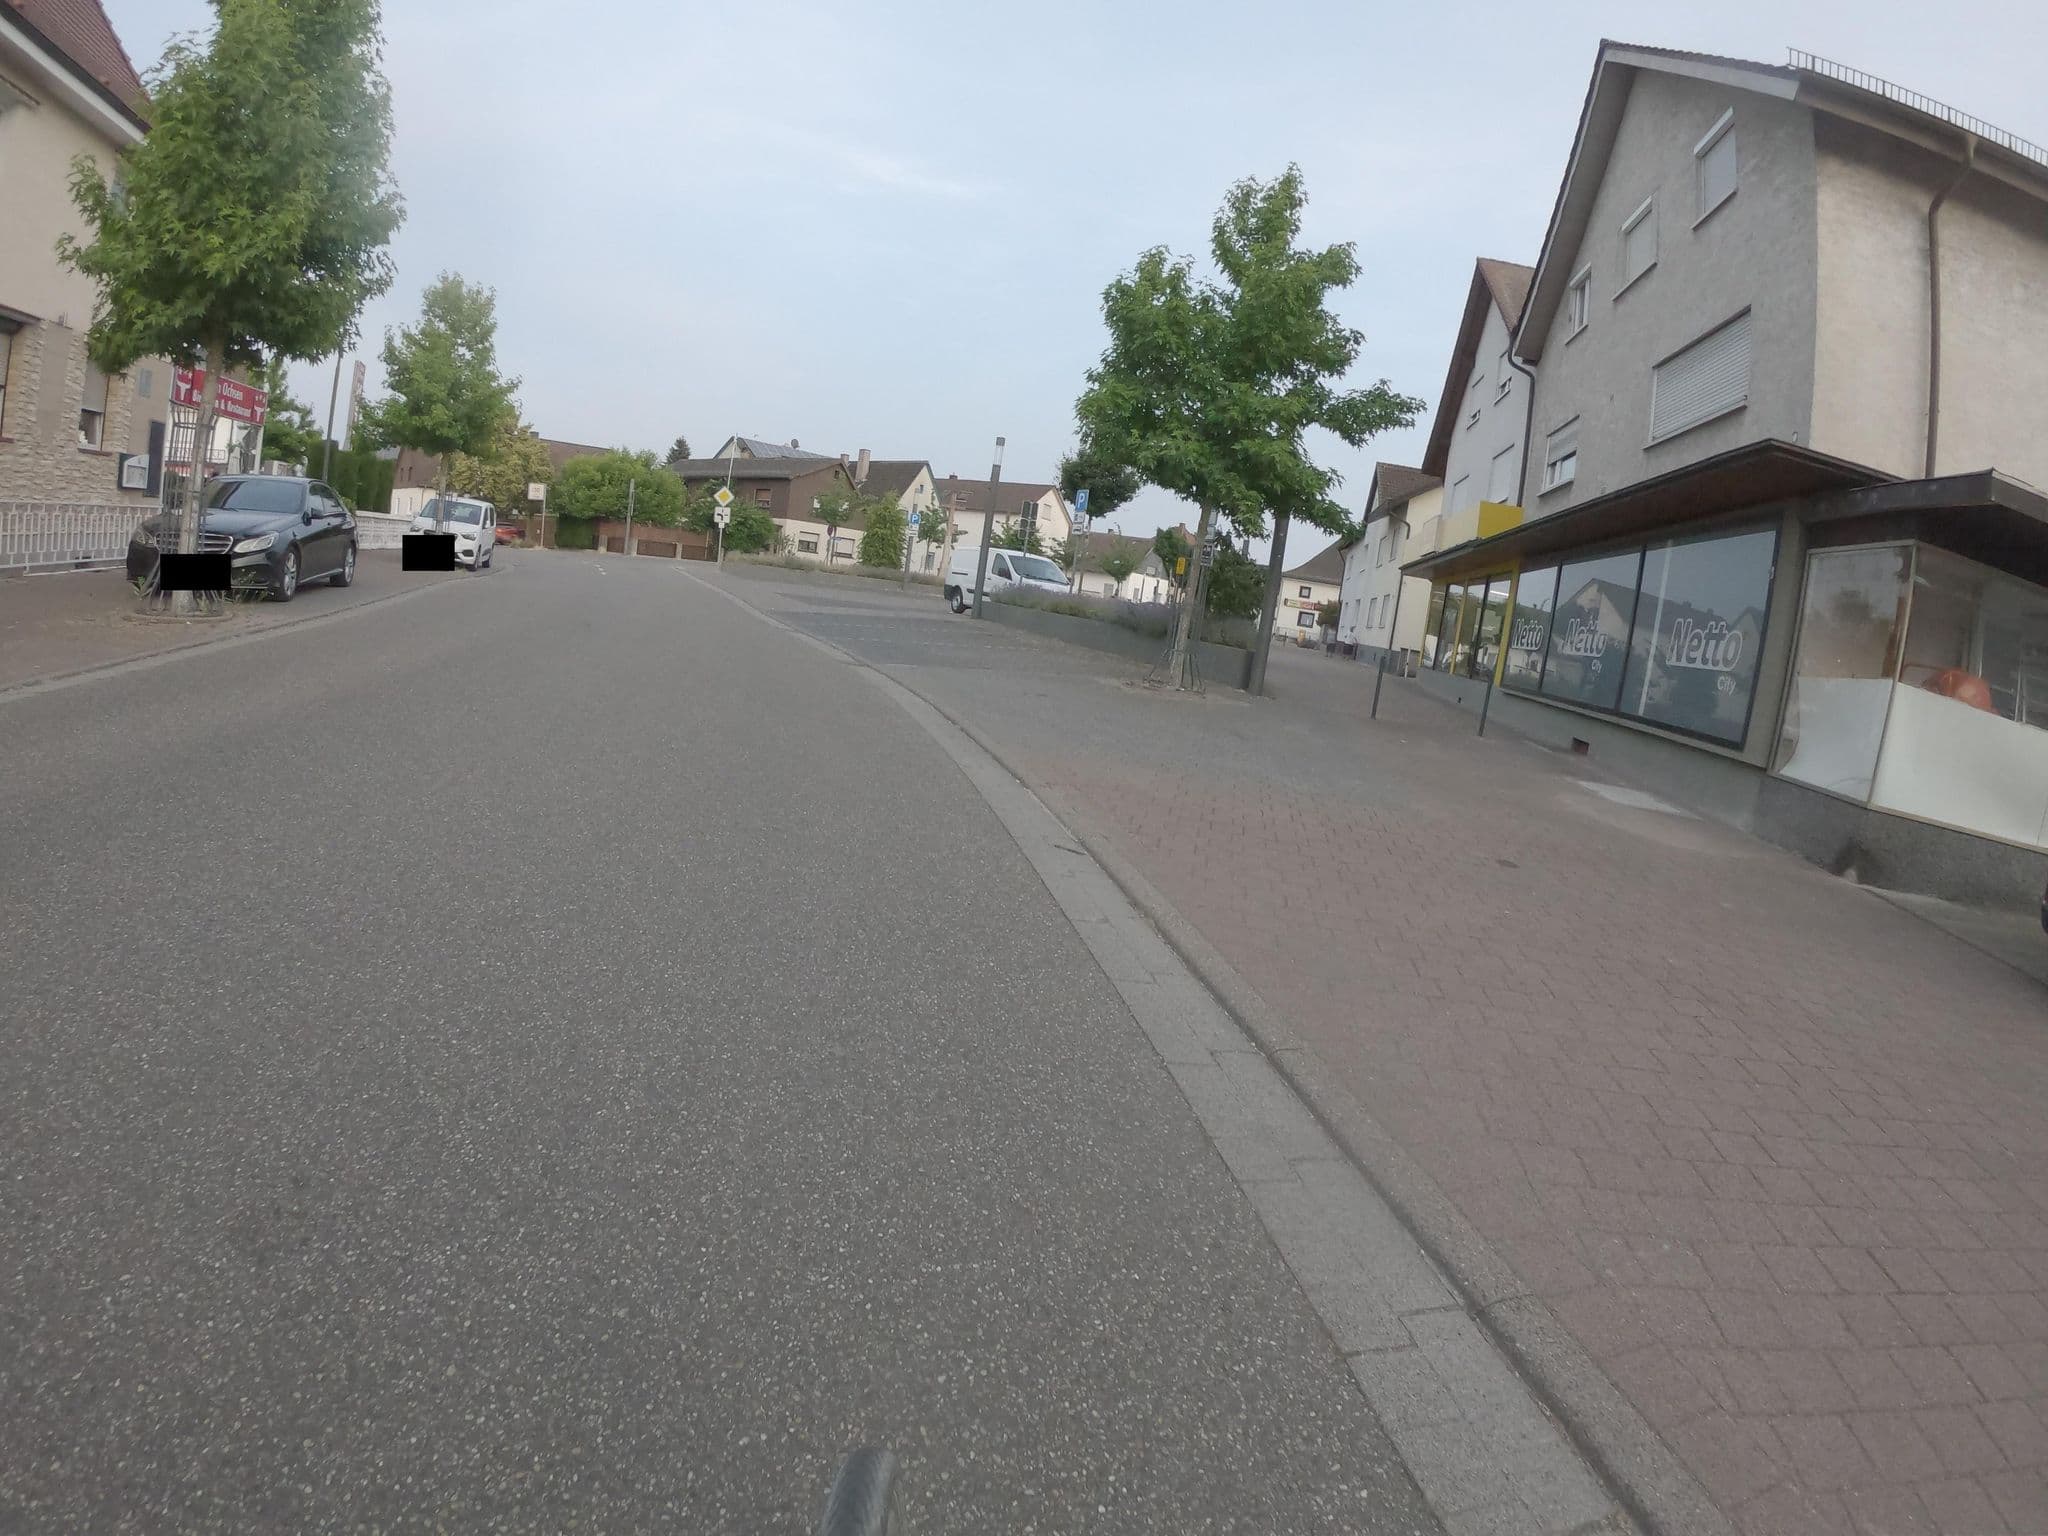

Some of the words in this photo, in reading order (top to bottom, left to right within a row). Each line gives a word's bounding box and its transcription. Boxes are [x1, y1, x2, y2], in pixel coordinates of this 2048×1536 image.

[222, 382, 243, 400] Ochsen
[1077, 492, 1085, 508] P
[911, 514, 918, 523] P
[1512, 618, 1544, 650] Netto
[1563, 618, 1608, 657] Netto
[1666, 618, 1743, 671] Netto
[1717, 675, 1737, 697] City
